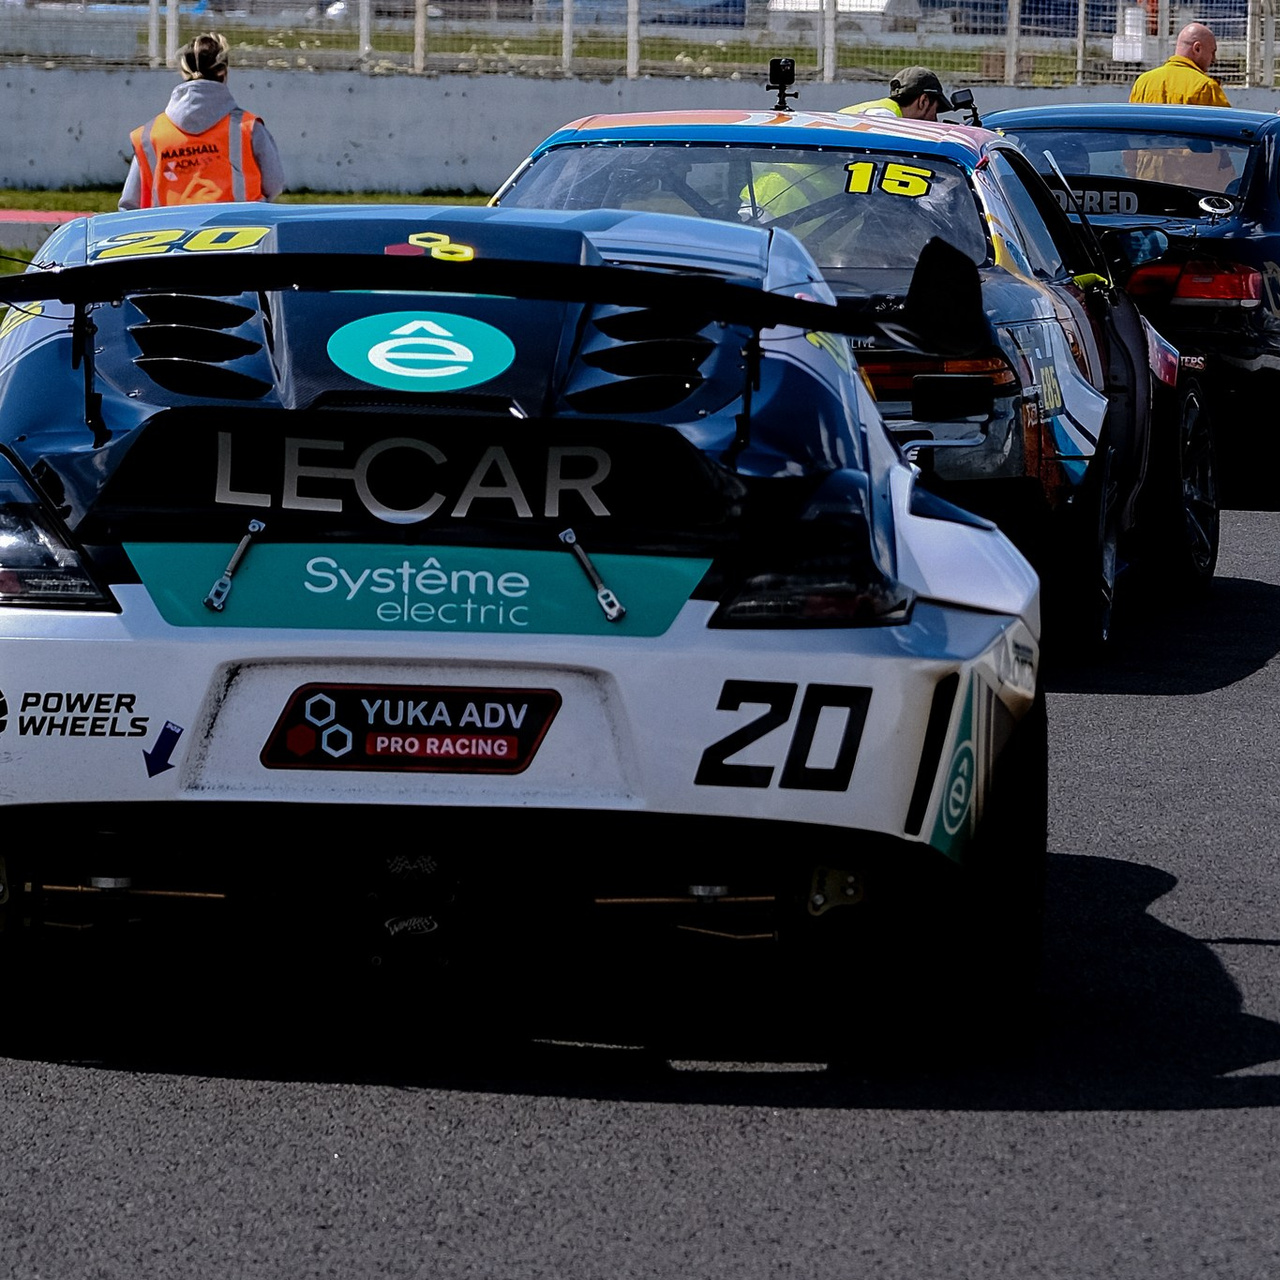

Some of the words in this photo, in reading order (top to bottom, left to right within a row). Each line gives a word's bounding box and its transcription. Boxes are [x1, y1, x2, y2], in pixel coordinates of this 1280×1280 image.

[161, 144, 219, 159] MARSHALL
[845, 161, 934, 197] 15
[95, 227, 272, 260] 20
[215, 431, 612, 525] LECAR
[376, 596, 529, 627] electric
[20, 693, 136, 713] POWER
[361, 699, 452, 727] YUKA
[459, 702, 528, 729] ADV
[19, 716, 150, 736] WHEELS
[693, 679, 873, 792] 20
[376, 736, 420, 754] PRO
[426, 737, 508, 756] RACING
